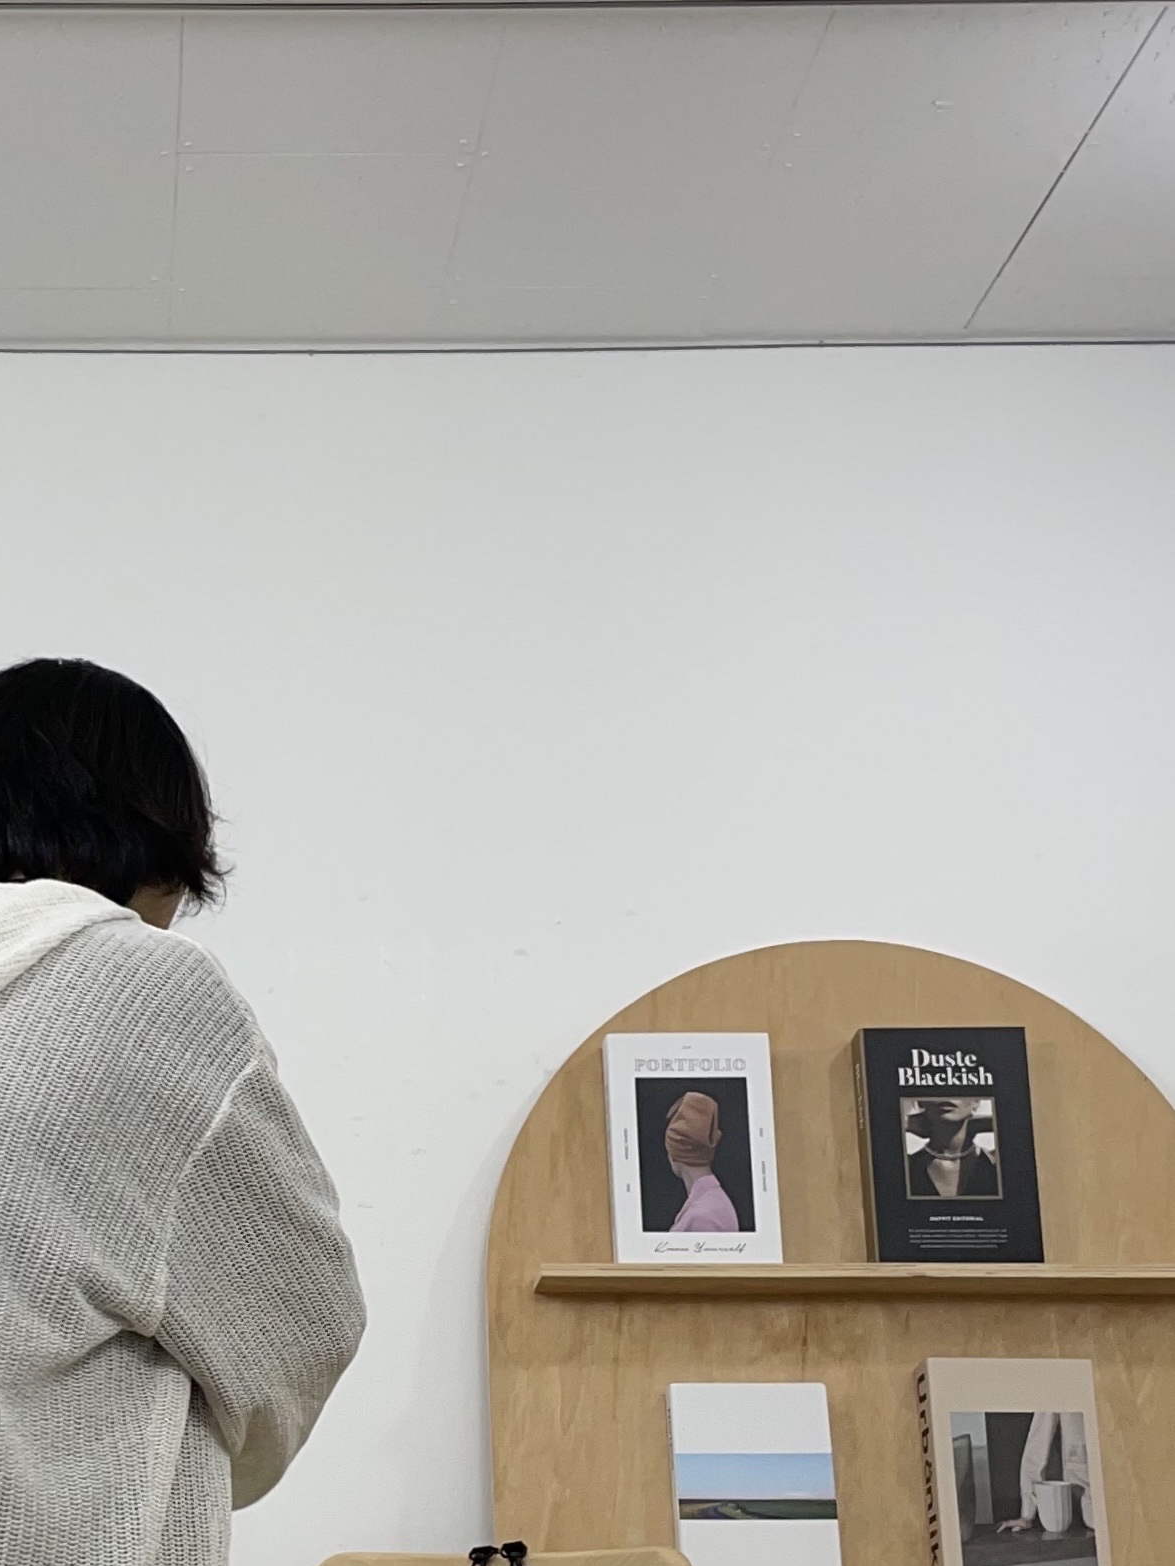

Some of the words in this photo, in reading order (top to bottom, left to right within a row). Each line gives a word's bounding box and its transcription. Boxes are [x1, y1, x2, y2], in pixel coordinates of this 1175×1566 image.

[634, 1058, 747, 1072] PORTFOLIO
[911, 1049, 977, 1067] Duste
[897, 1066, 994, 1086] Blackish
